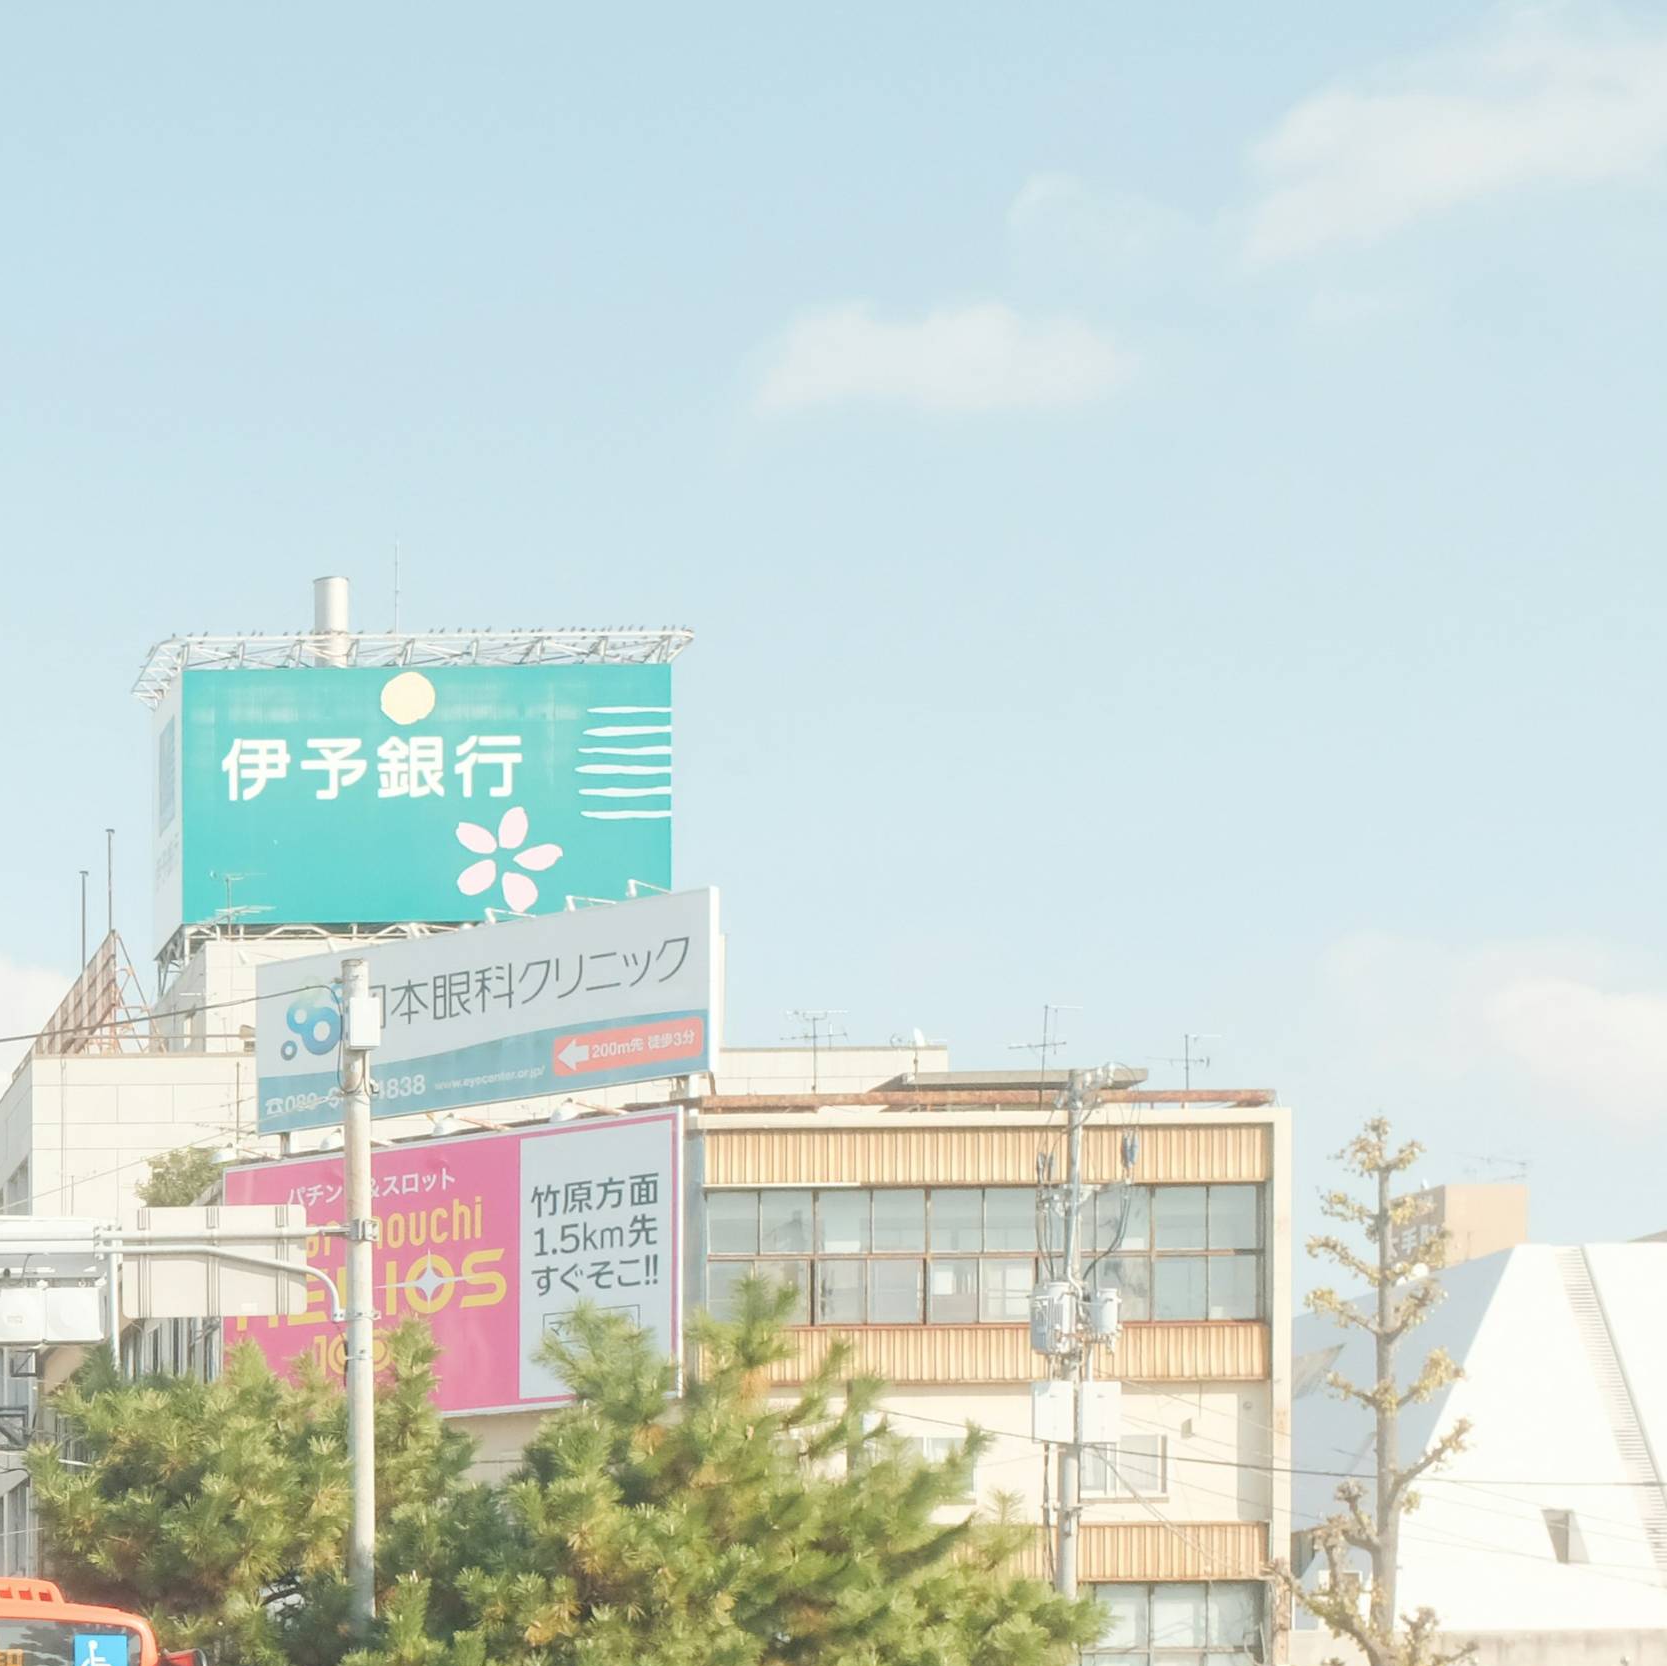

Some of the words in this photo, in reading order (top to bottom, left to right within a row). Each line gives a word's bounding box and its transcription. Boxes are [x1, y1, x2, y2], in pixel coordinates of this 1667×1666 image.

[221, 735, 523, 801] 伊予銀行
[530, 1172, 659, 1219] 竹原方面
[533, 1213, 658, 1258] 1.5km先
[531, 1253, 659, 1297] すぐそこ!!
